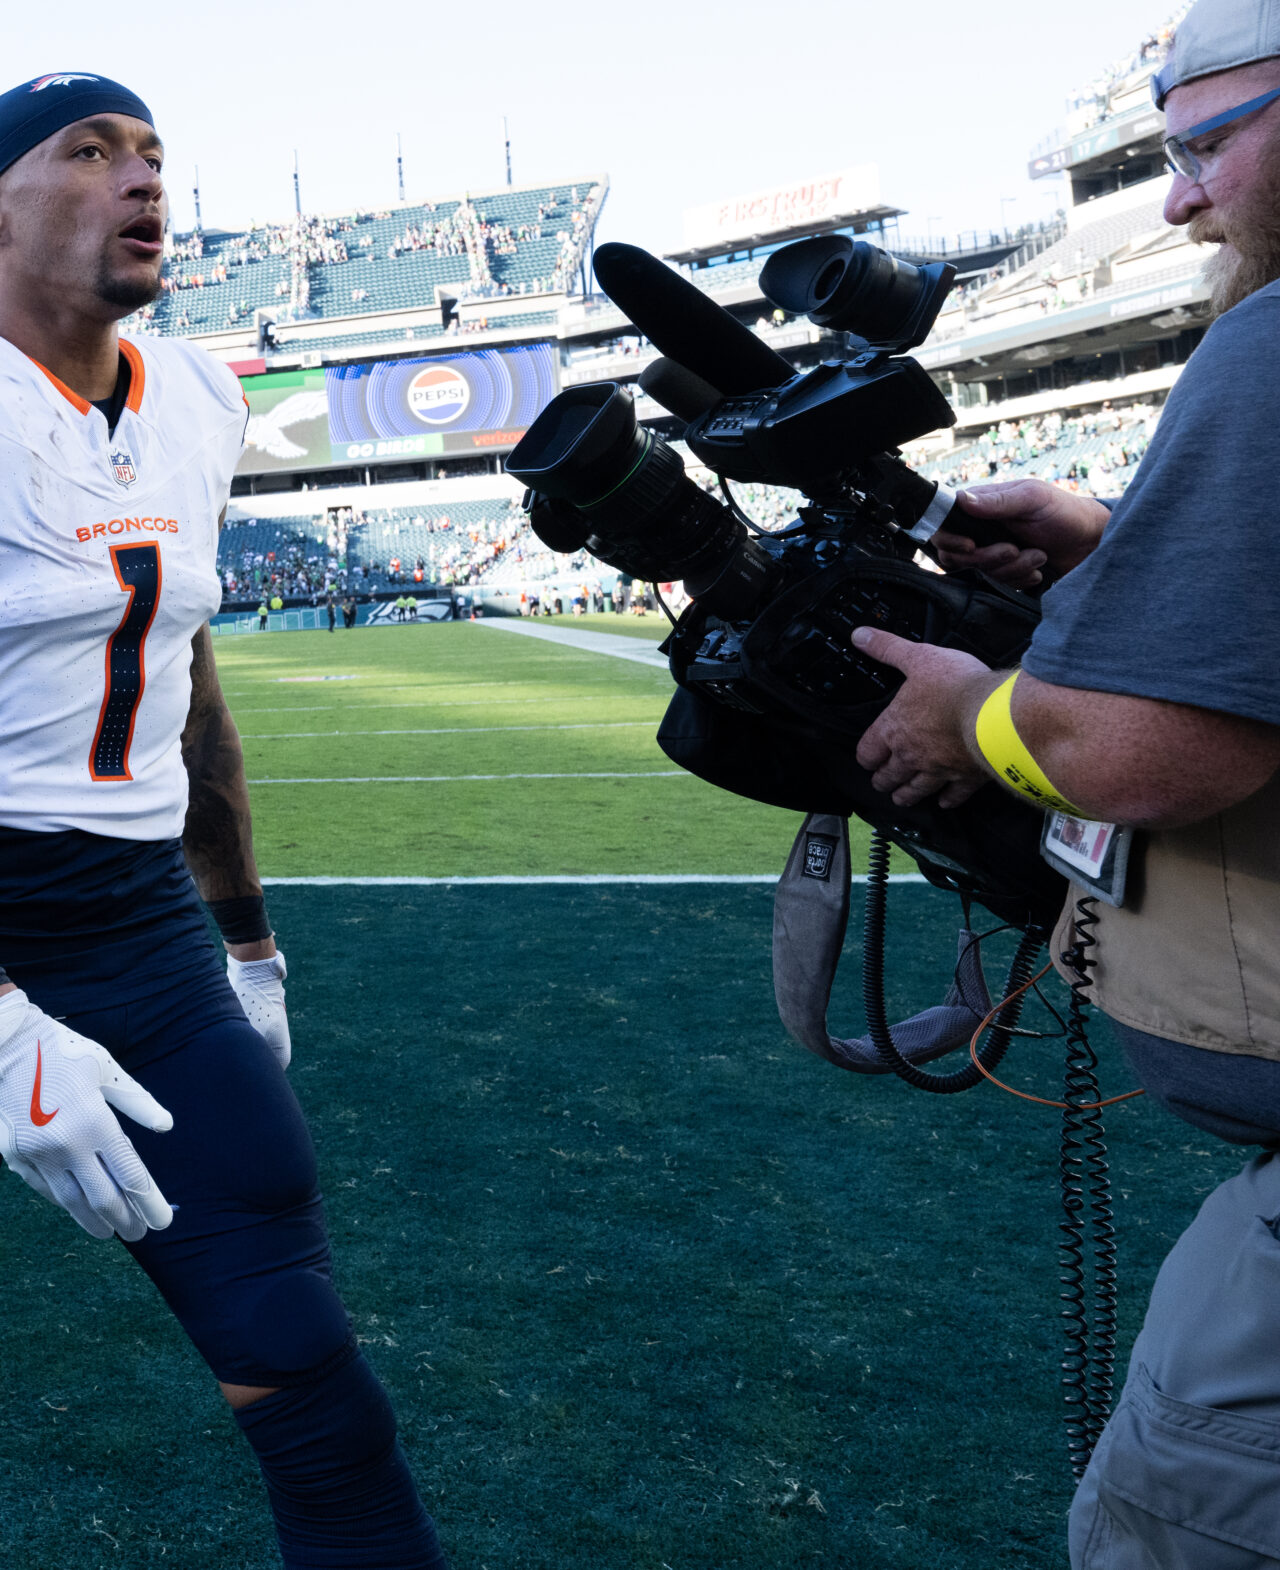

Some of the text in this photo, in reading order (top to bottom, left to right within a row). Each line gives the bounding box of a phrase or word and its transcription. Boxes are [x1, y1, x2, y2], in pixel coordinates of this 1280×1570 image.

[1077, 141, 1091, 156] 17
[1051, 151, 1066, 167] 21
[413, 386, 465, 403] PEPSI
[347, 438, 426, 459] GO BIRDS
[76, 516, 179, 543] BRONCOS
[743, 551, 767, 574] Canon
[88, 539, 163, 782] 1
[808, 845, 830, 857] brace
[807, 856, 827, 869] porta
